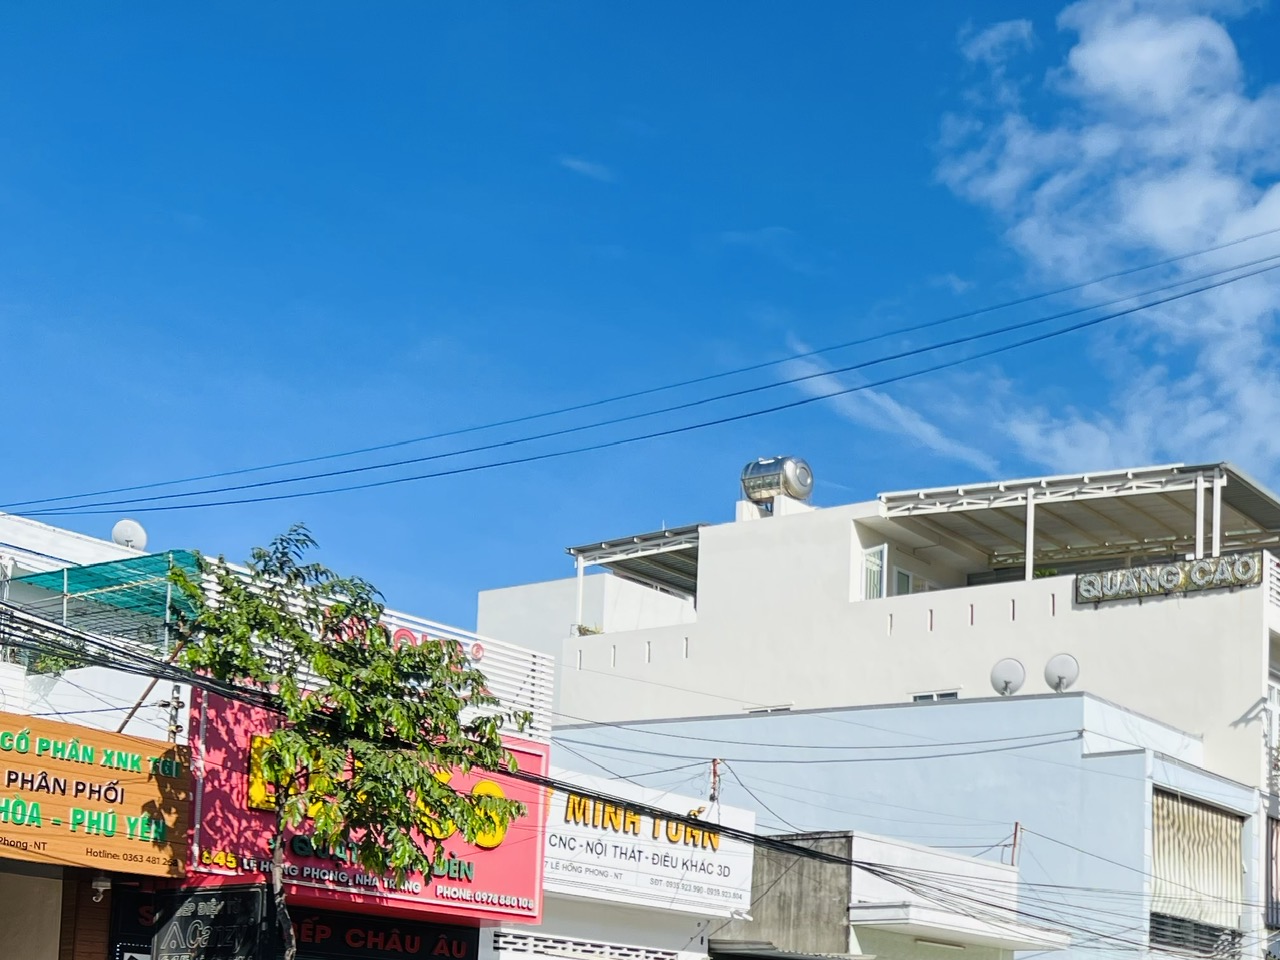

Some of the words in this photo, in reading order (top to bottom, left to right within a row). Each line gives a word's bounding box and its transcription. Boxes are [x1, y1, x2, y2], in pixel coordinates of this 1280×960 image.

[101, 749, 142, 773] XNK
[5, 770, 67, 796] PHÂN
[73, 780, 125, 804] PHỐI
[70, 808, 118, 838] PHÚ
[565, 792, 641, 836] MINH
[122, 852, 144, 863] 0363
[201, 850, 237, 870] 645
[355, 873, 379, 888] NHA
[548, 834, 577, 851] CNC
[585, 841, 608, 859] NỘI
[717, 864, 731, 878] 3D
[584, 867, 609, 878] PHONG
[613, 872, 622, 880] NT
[345, 927, 420, 953] CHÂU
[432, 934, 467, 958] ÂU
